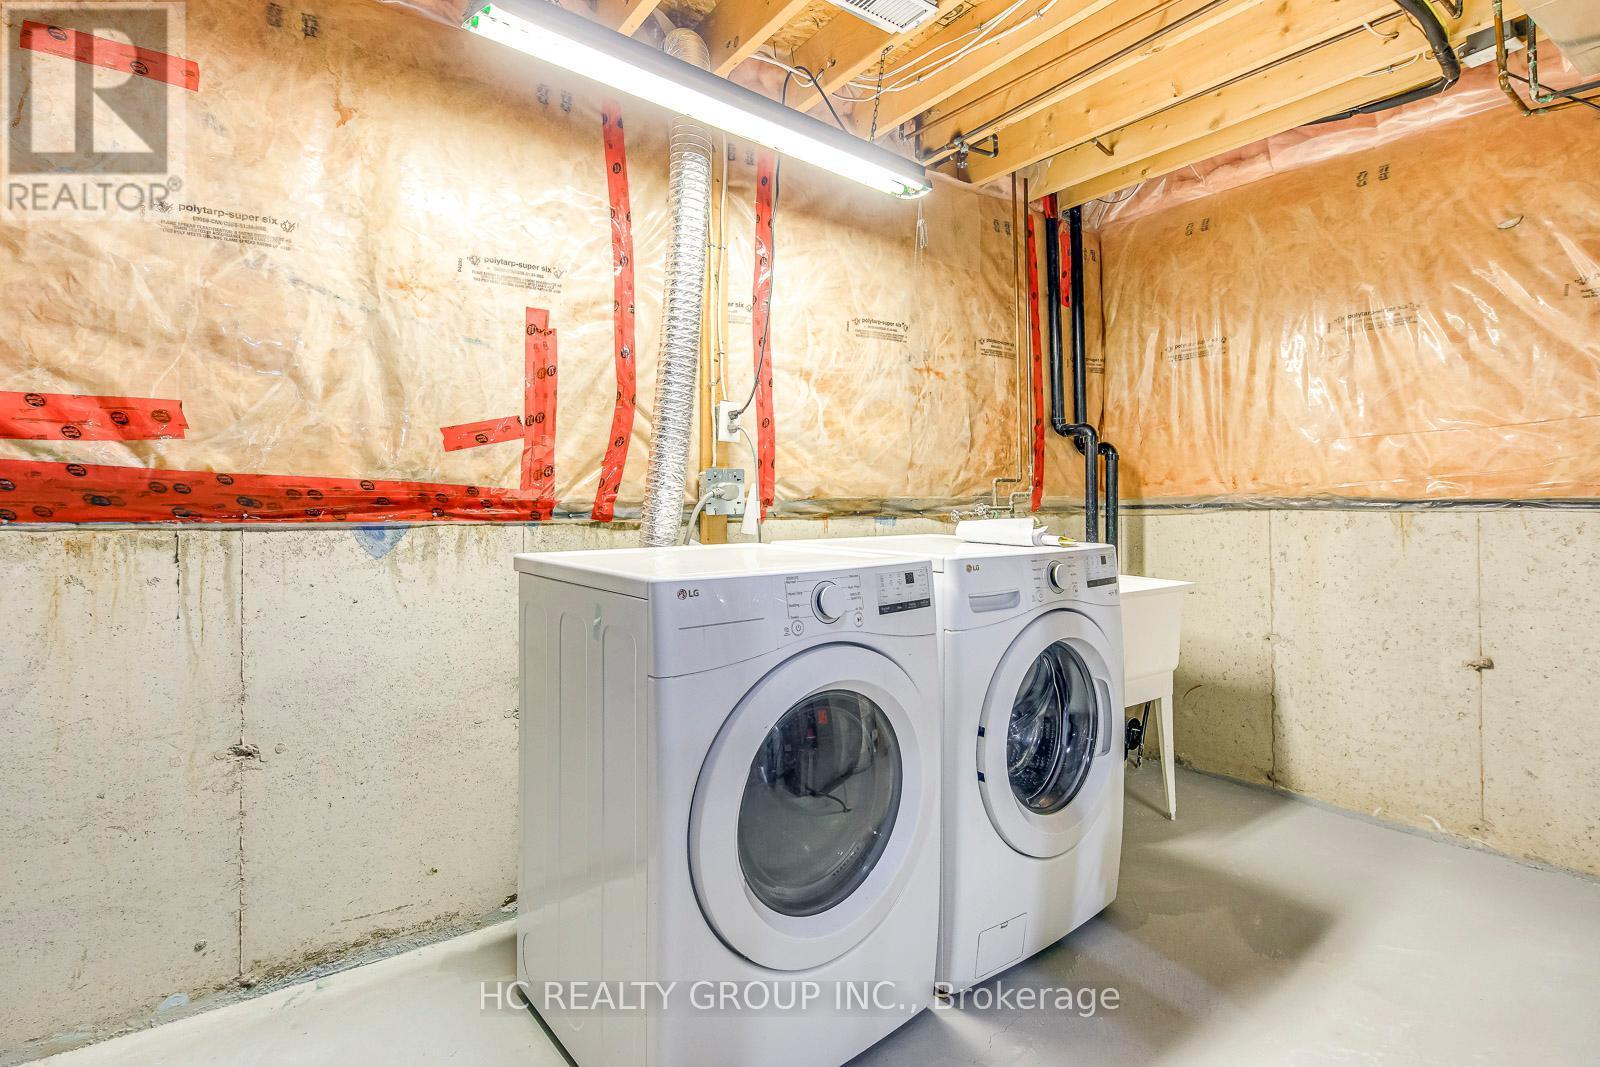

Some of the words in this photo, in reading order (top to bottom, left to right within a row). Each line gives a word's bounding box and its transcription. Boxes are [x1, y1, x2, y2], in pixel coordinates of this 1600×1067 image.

[178, 203, 260, 221] polytarp-super
[262, 215, 279, 226] six
[483, 256, 540, 271] polytarp-super
[541, 265, 552, 274] six
[688, 589, 699, 598] LG
